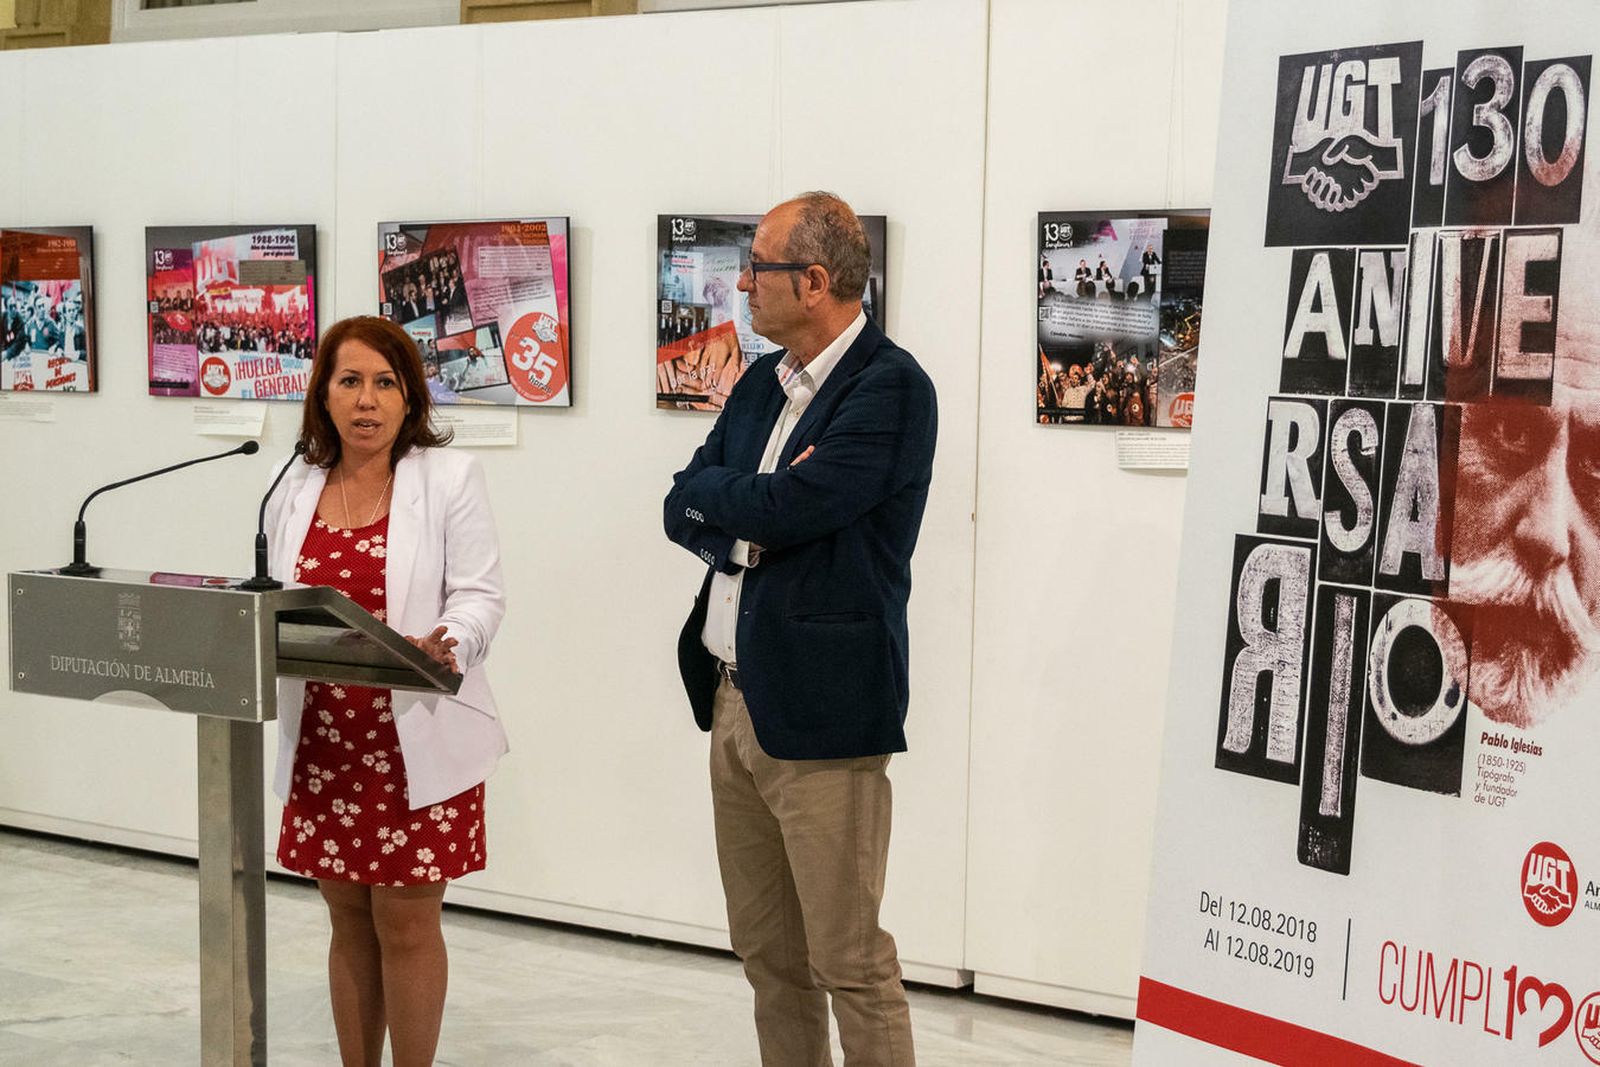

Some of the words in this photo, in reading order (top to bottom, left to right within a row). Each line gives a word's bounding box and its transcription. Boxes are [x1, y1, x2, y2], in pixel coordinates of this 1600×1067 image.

[1291, 57, 1402, 153] UGT
[1420, 55, 1586, 187] 130
[252, 235, 295, 244] 1988-1994
[511, 336, 558, 388] 35
[254, 373, 308, 399] GENERAL!
[50, 655, 130, 679] DIPUTACIÓN
[134, 664, 152, 682] DE
[155, 667, 215, 689] ALMERÍA
[1480, 731, 1509, 749] Pablo
[1511, 736, 1543, 757] Iglesias
[1477, 753, 1527, 775] (1850-1925)
[1477, 766, 1515, 784] Tipógrafo
[1474, 782, 1481, 792] y
[1483, 780, 1518, 798] fundador
[1474, 792, 1486, 804] de
[1488, 795, 1507, 807] UGT
[1526, 852, 1570, 893] UGT
[1199, 891, 1223, 918] Del
[1229, 901, 1318, 943] 12.08.2018
[1203, 928, 1220, 952] Al
[1227, 935, 1315, 979] 12.08.2019
